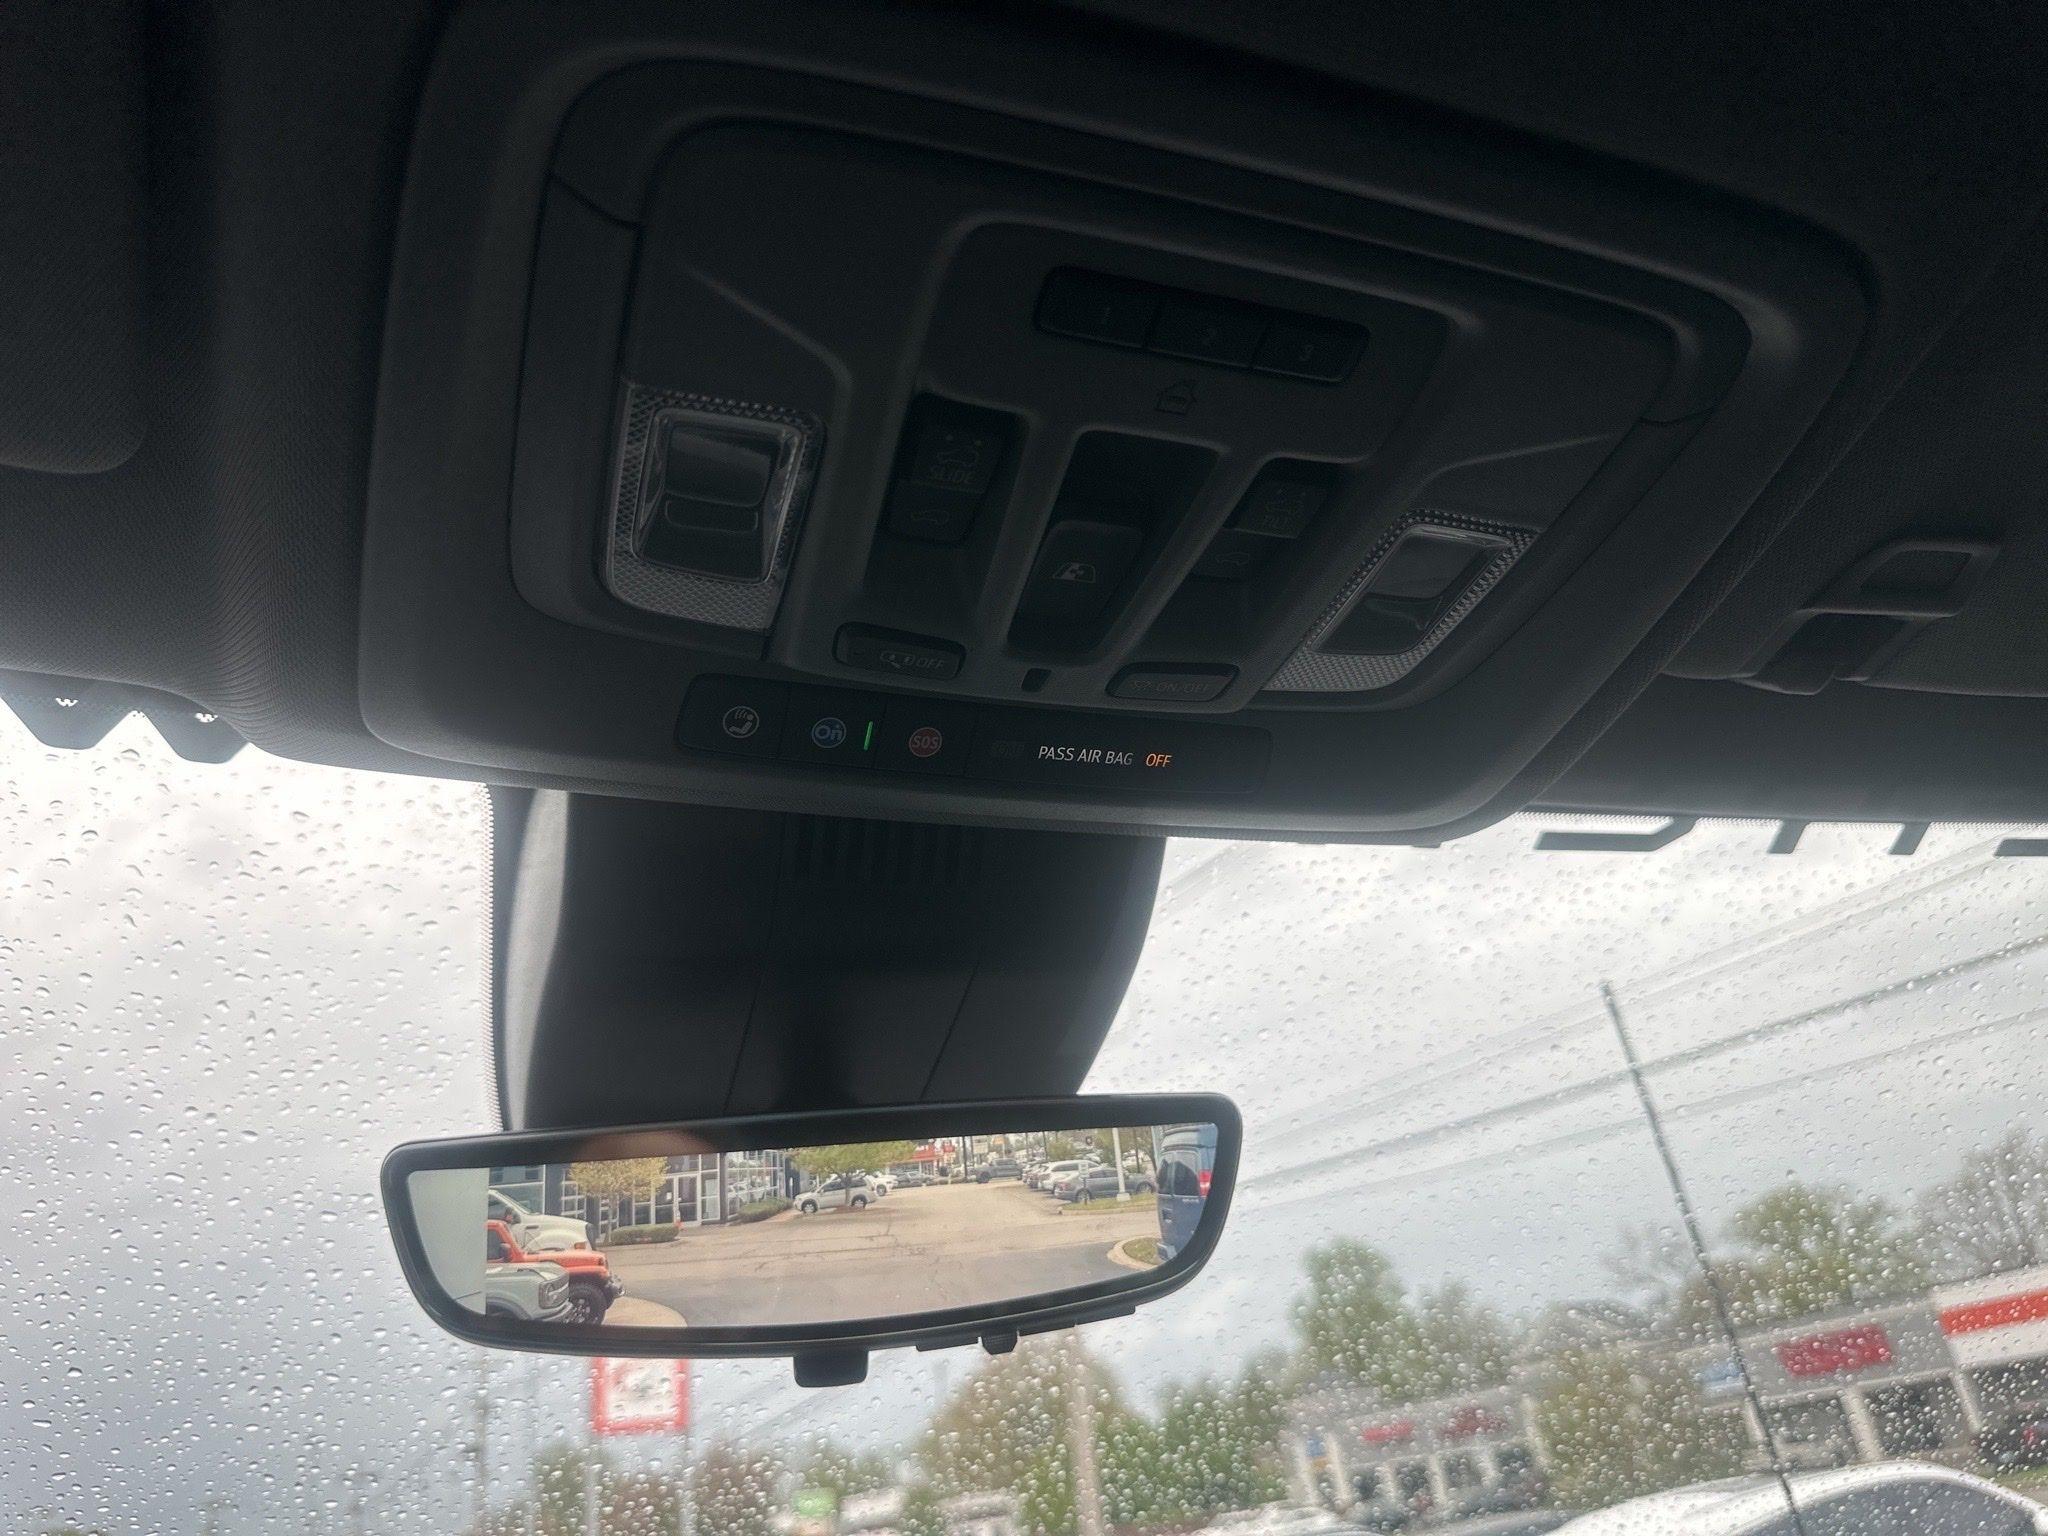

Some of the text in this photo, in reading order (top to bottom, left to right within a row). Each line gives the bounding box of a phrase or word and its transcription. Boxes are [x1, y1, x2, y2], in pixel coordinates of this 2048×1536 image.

[929, 465, 976, 486] SLIDE
[916, 657, 946, 669] OFF
[815, 723, 843, 741] On
[912, 735, 939, 750] SOS
[1038, 745, 1075, 762] PASS
[1077, 748, 1102, 763] AIR
[1105, 751, 1134, 766] BAG
[1145, 753, 1173, 768] OFF
